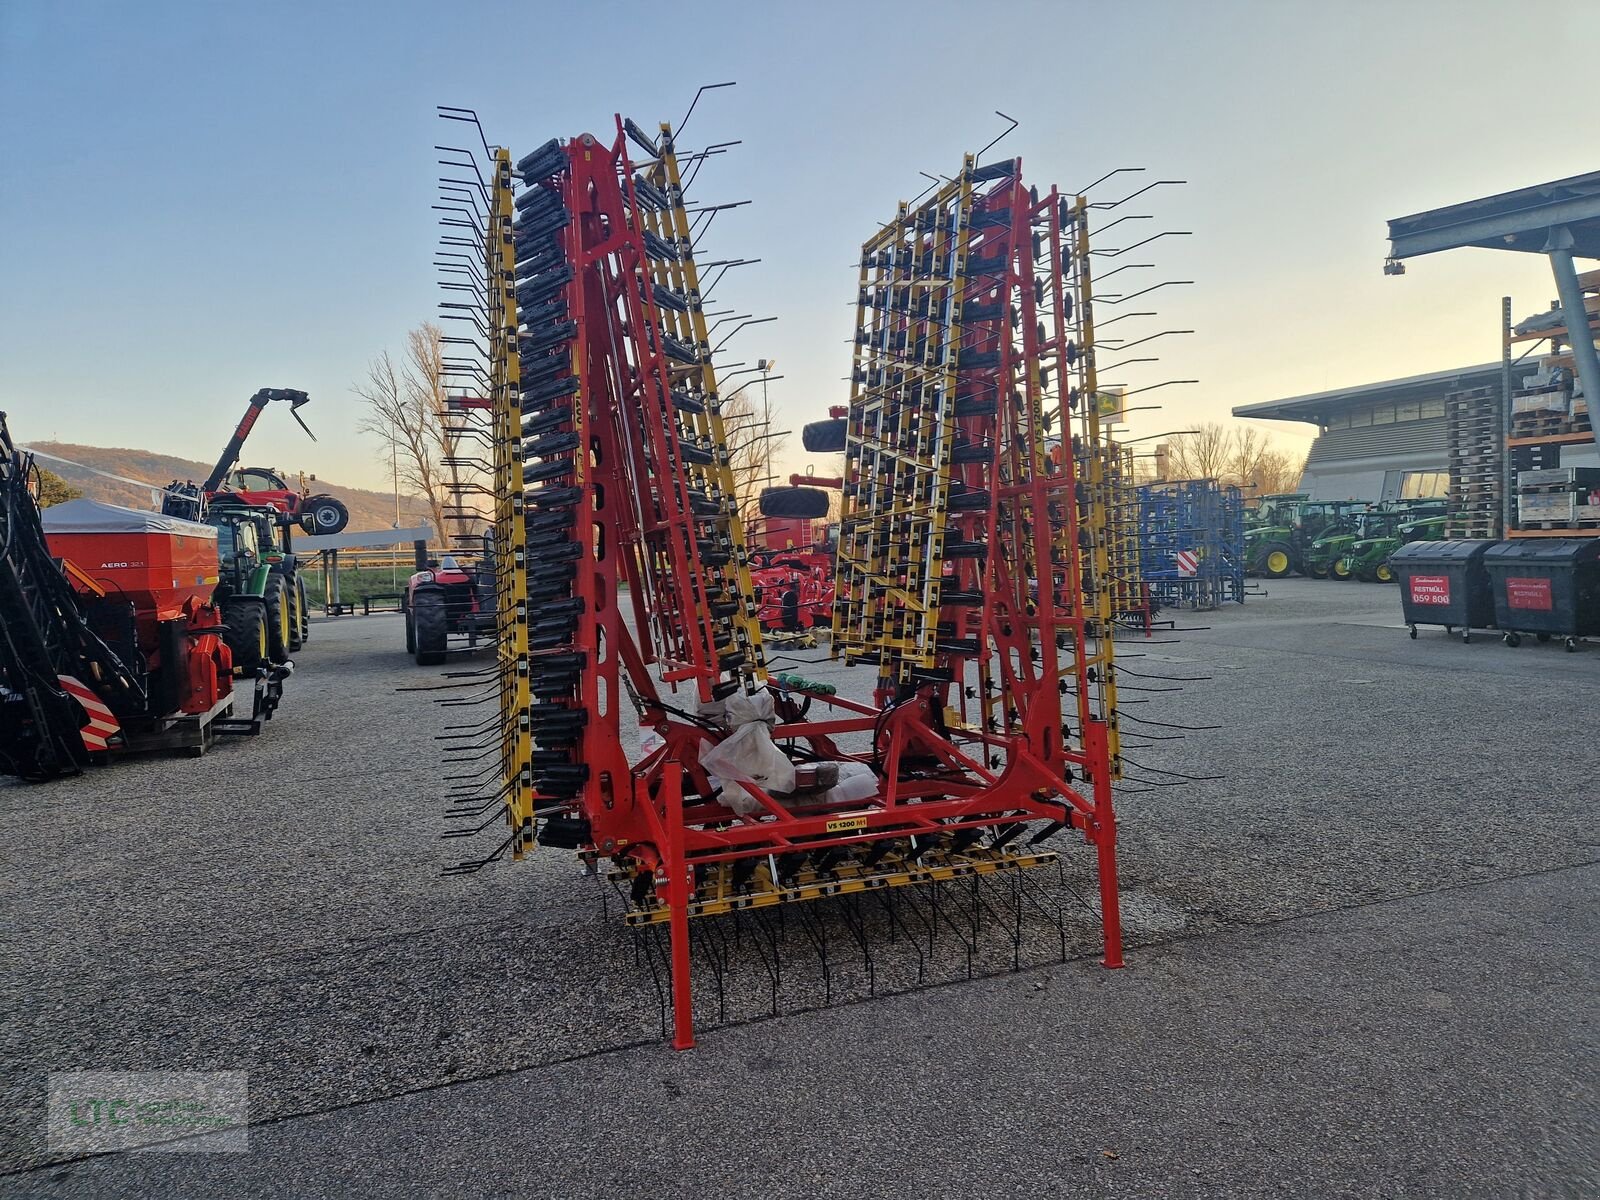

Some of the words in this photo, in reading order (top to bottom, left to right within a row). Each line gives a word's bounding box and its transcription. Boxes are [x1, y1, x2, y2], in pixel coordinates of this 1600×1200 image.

[1033, 400, 1041, 427] 1200
[1414, 585, 1445, 593] RESTMÜLL
[1413, 594, 1430, 603] 059
[1432, 595, 1449, 604] 800
